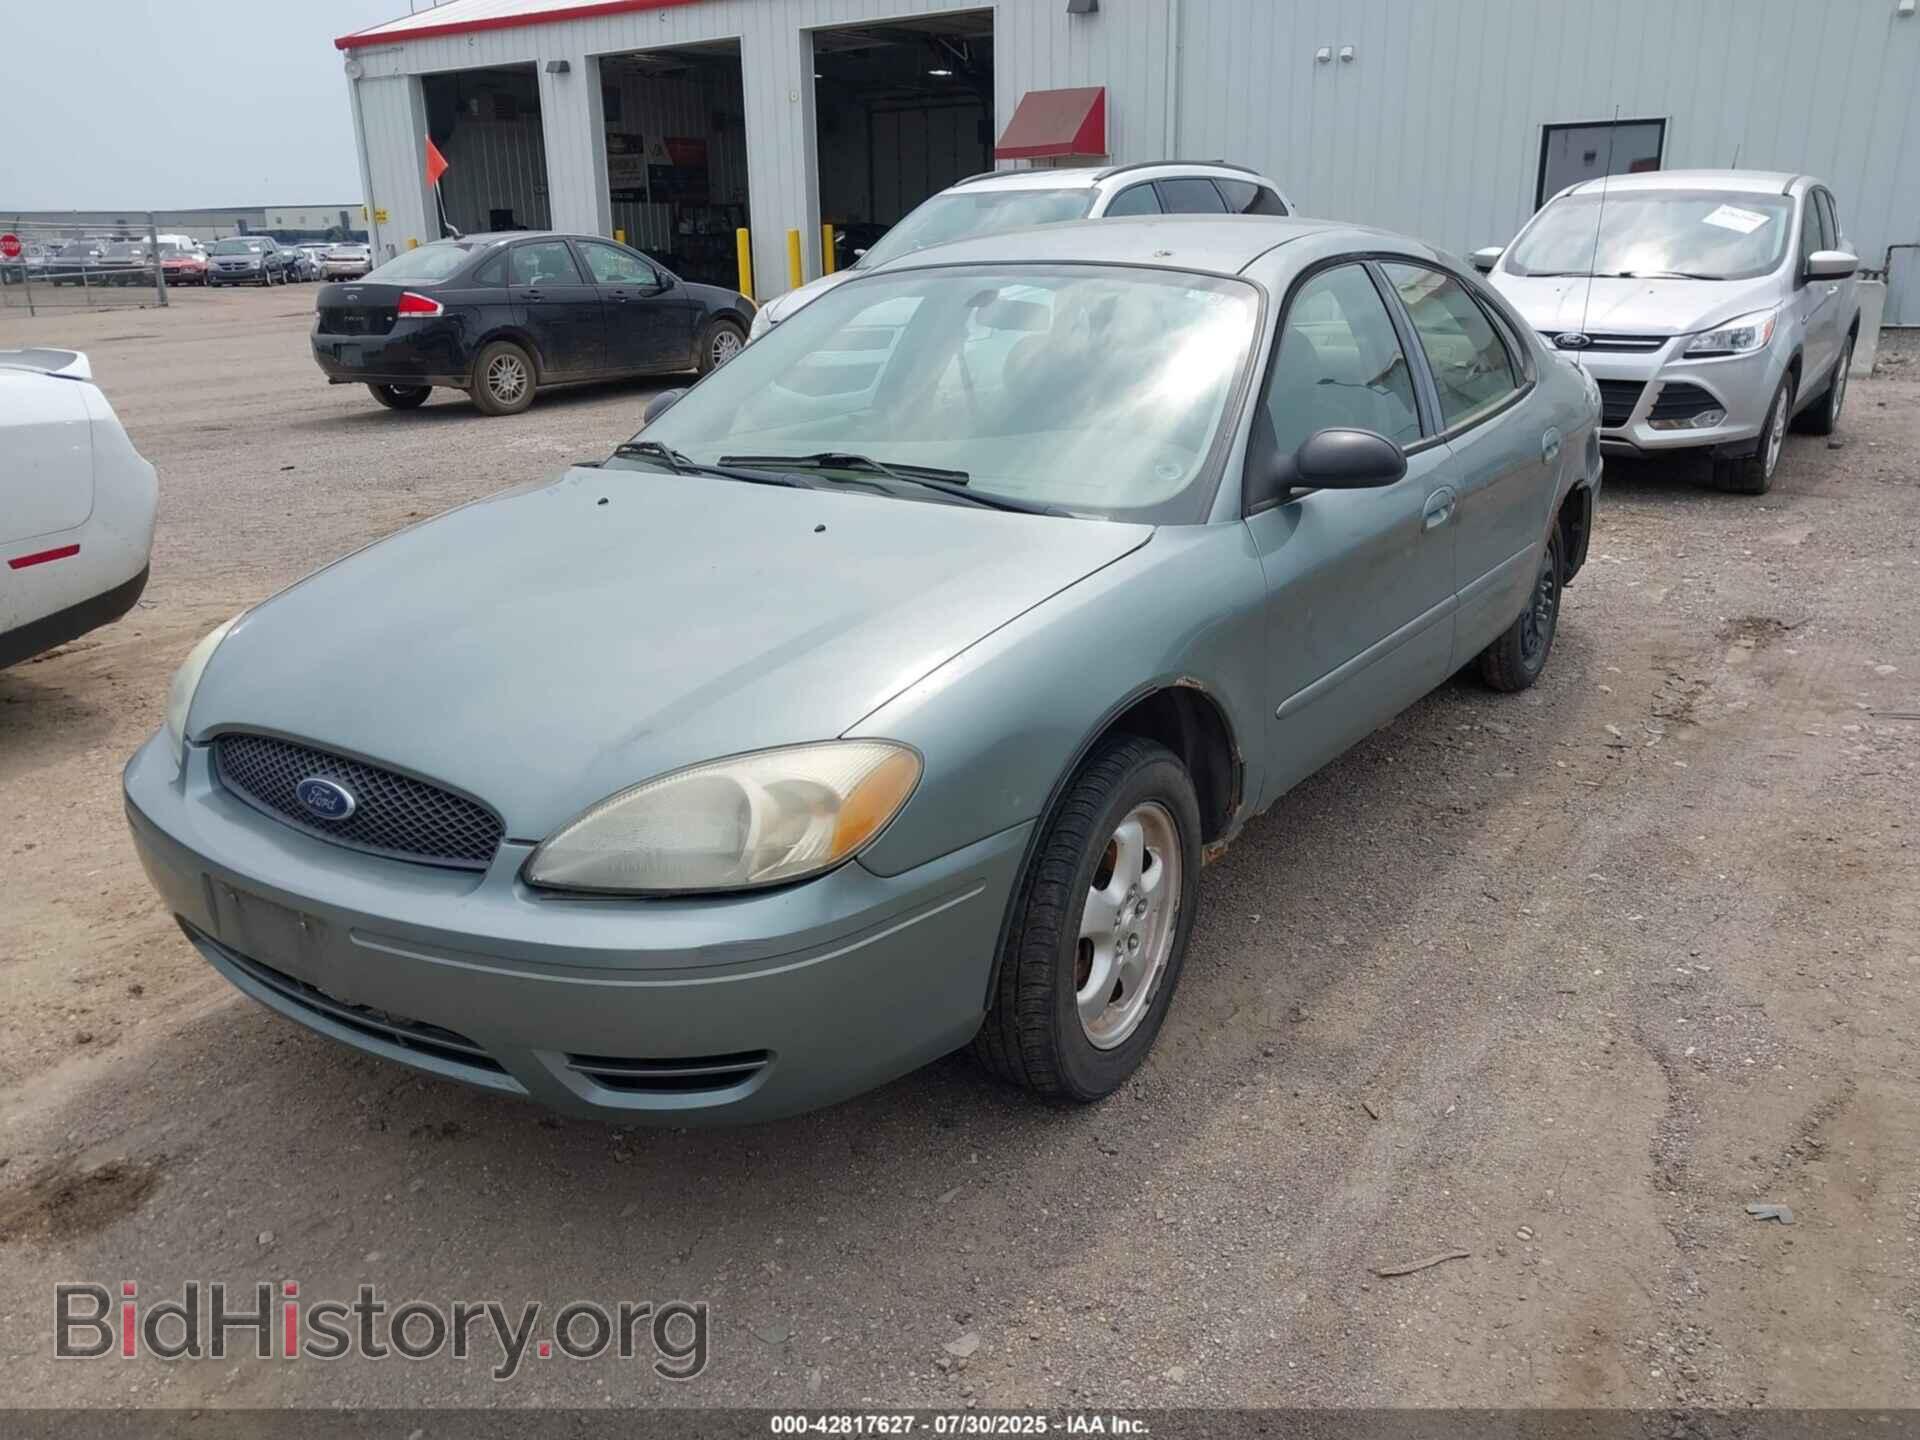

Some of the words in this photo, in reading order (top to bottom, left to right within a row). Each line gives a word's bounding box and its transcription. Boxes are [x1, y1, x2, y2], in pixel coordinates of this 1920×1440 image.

[0, 240, 21, 251] STOP
[1560, 334, 1582, 346] Ford
[308, 785, 338, 810] Ford
